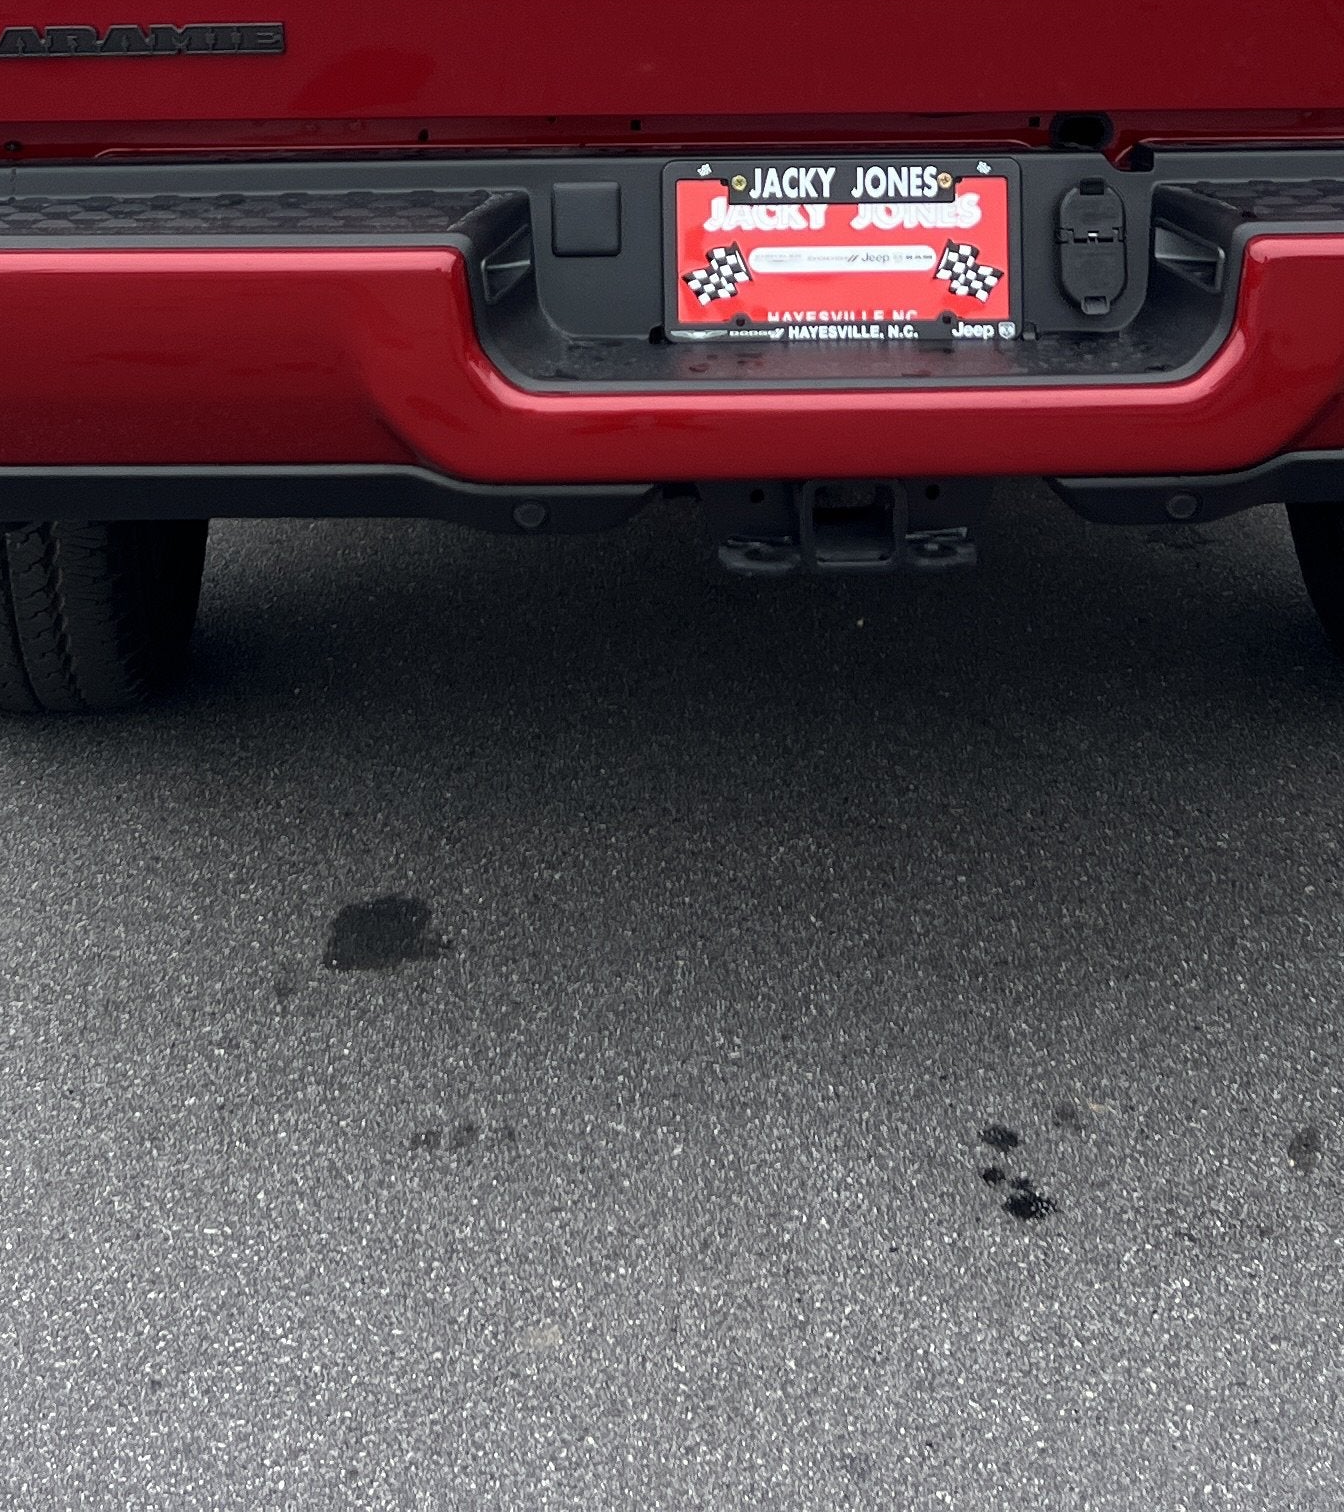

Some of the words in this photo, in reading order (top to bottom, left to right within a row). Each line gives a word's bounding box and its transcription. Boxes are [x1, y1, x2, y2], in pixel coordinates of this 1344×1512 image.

[749, 167, 836, 199] JACKY
[851, 166, 938, 197] JONES
[703, 196, 828, 231] JACKY
[850, 193, 982, 230] JONES
[862, 252, 890, 264] Jeep
[788, 325, 884, 339] HAYESVILLE,
[888, 325, 919, 338] N.C.
[952, 322, 994, 339] Jeep
